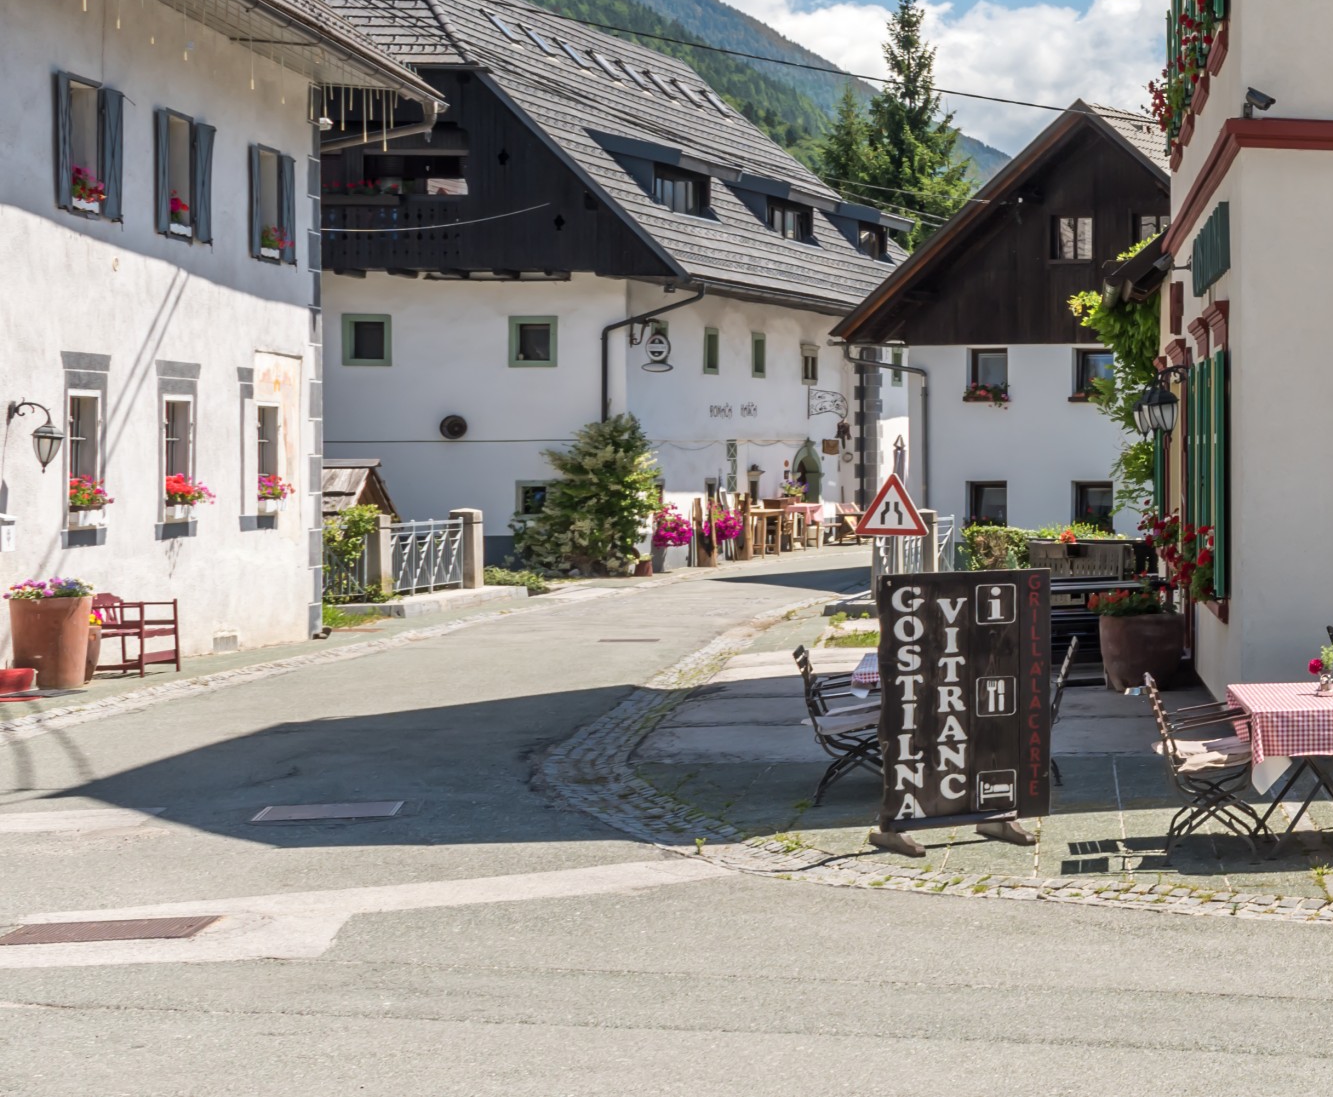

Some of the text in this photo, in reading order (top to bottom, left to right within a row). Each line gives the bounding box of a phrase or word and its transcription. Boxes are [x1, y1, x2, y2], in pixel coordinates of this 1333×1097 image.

[1028, 574, 1042, 657] GRILL
[891, 586, 927, 820] GOSTILNA
[936, 597, 968, 800] VITRANC
[1028, 714, 1042, 797] CARTE
